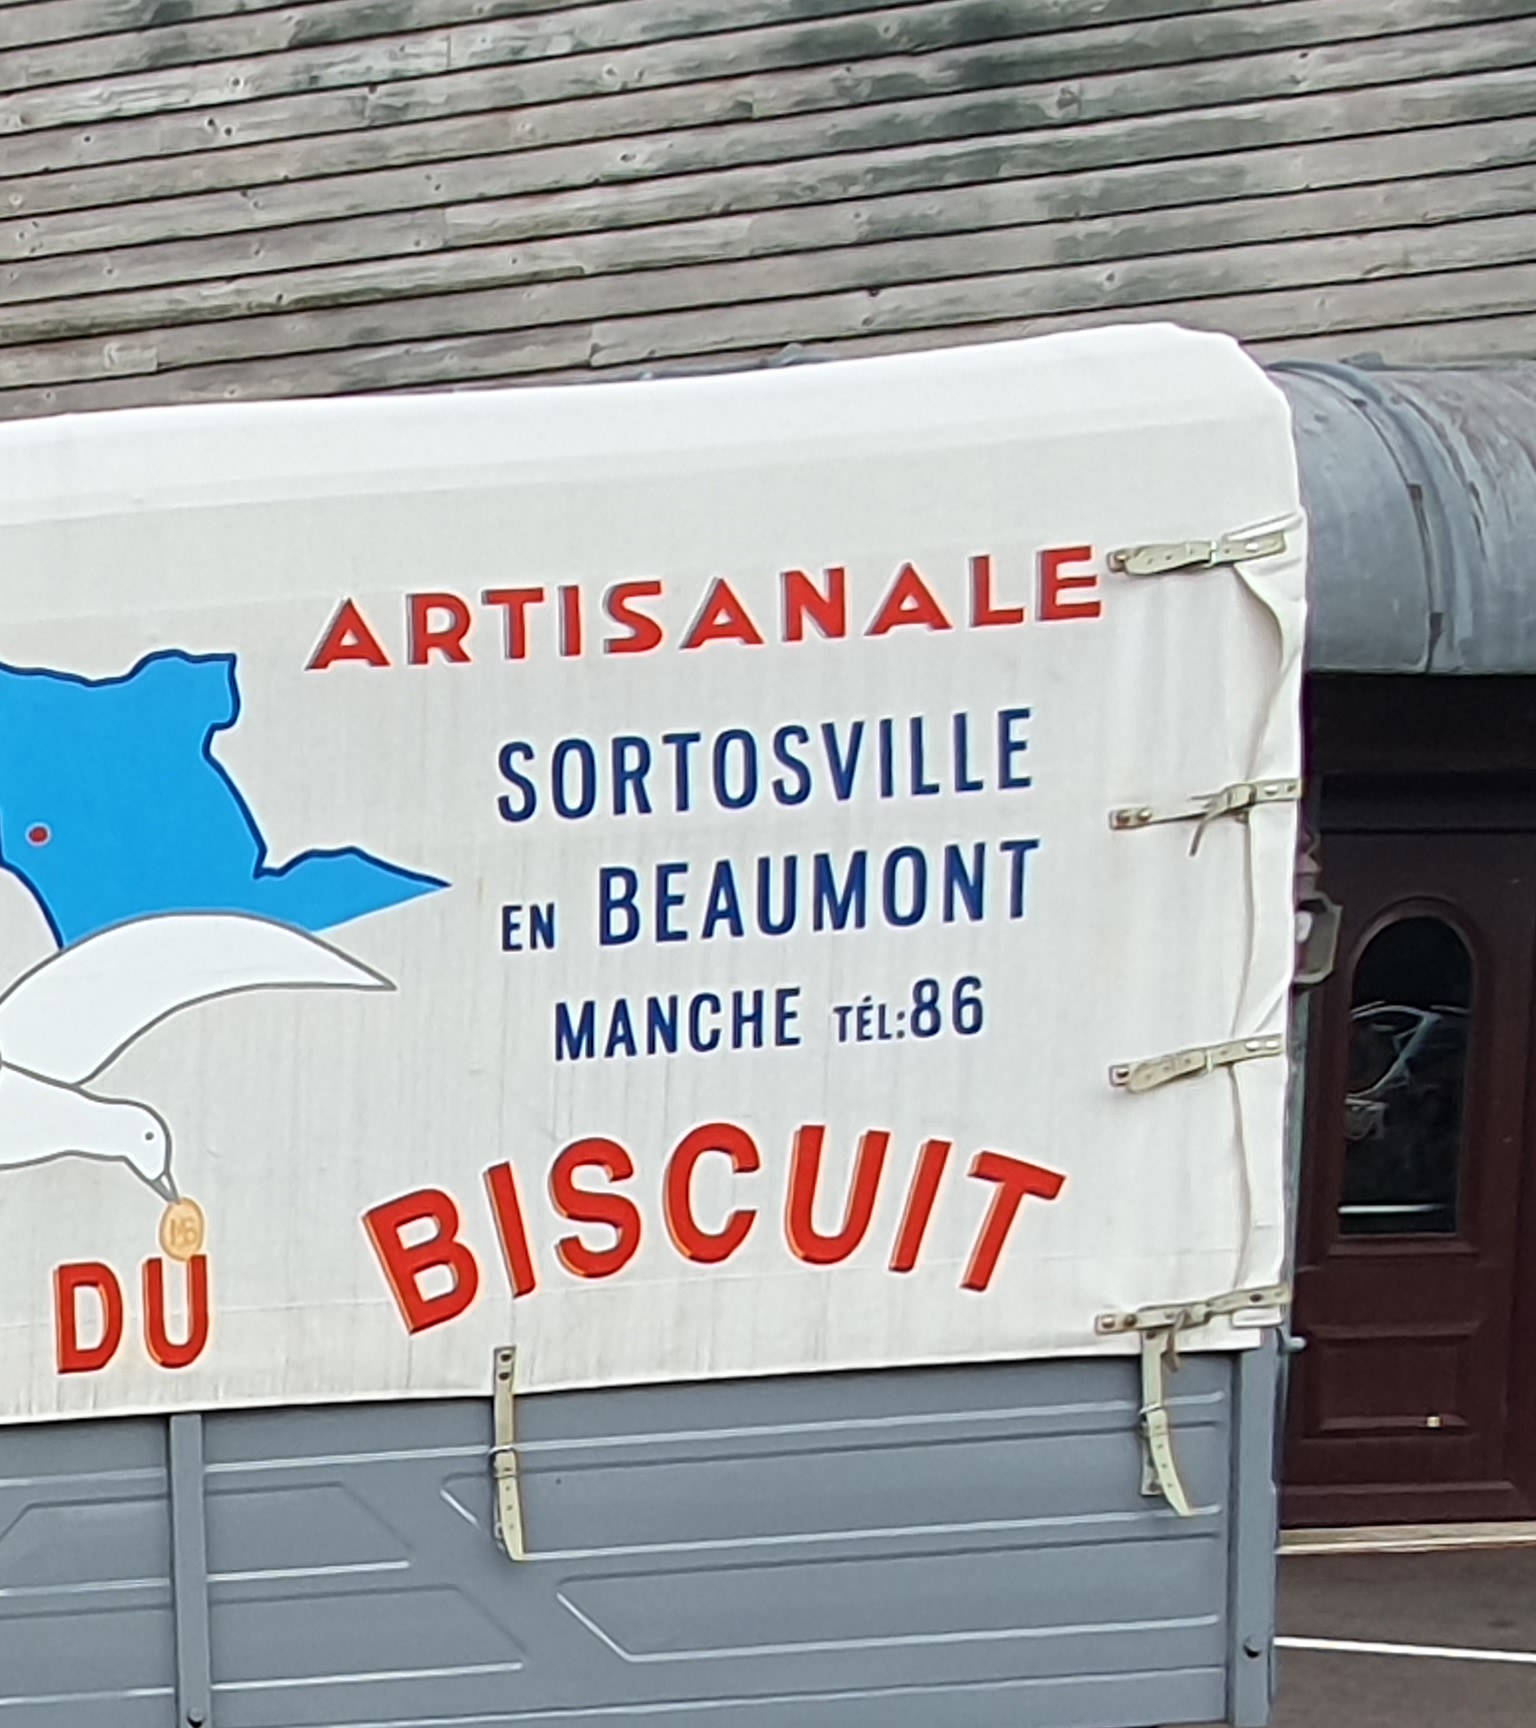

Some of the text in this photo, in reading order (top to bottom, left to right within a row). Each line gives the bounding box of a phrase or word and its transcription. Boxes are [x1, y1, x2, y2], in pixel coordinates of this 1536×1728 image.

[306, 546, 1103, 671] ARTISANALE
[496, 706, 1033, 823] SORTOSVILLE
[500, 839, 1040, 952] EN BEAUMONT
[554, 986, 801, 1061] MANCHE
[53, 1253, 211, 1375] DU
[361, 1121, 1067, 1335] BISCUIT
